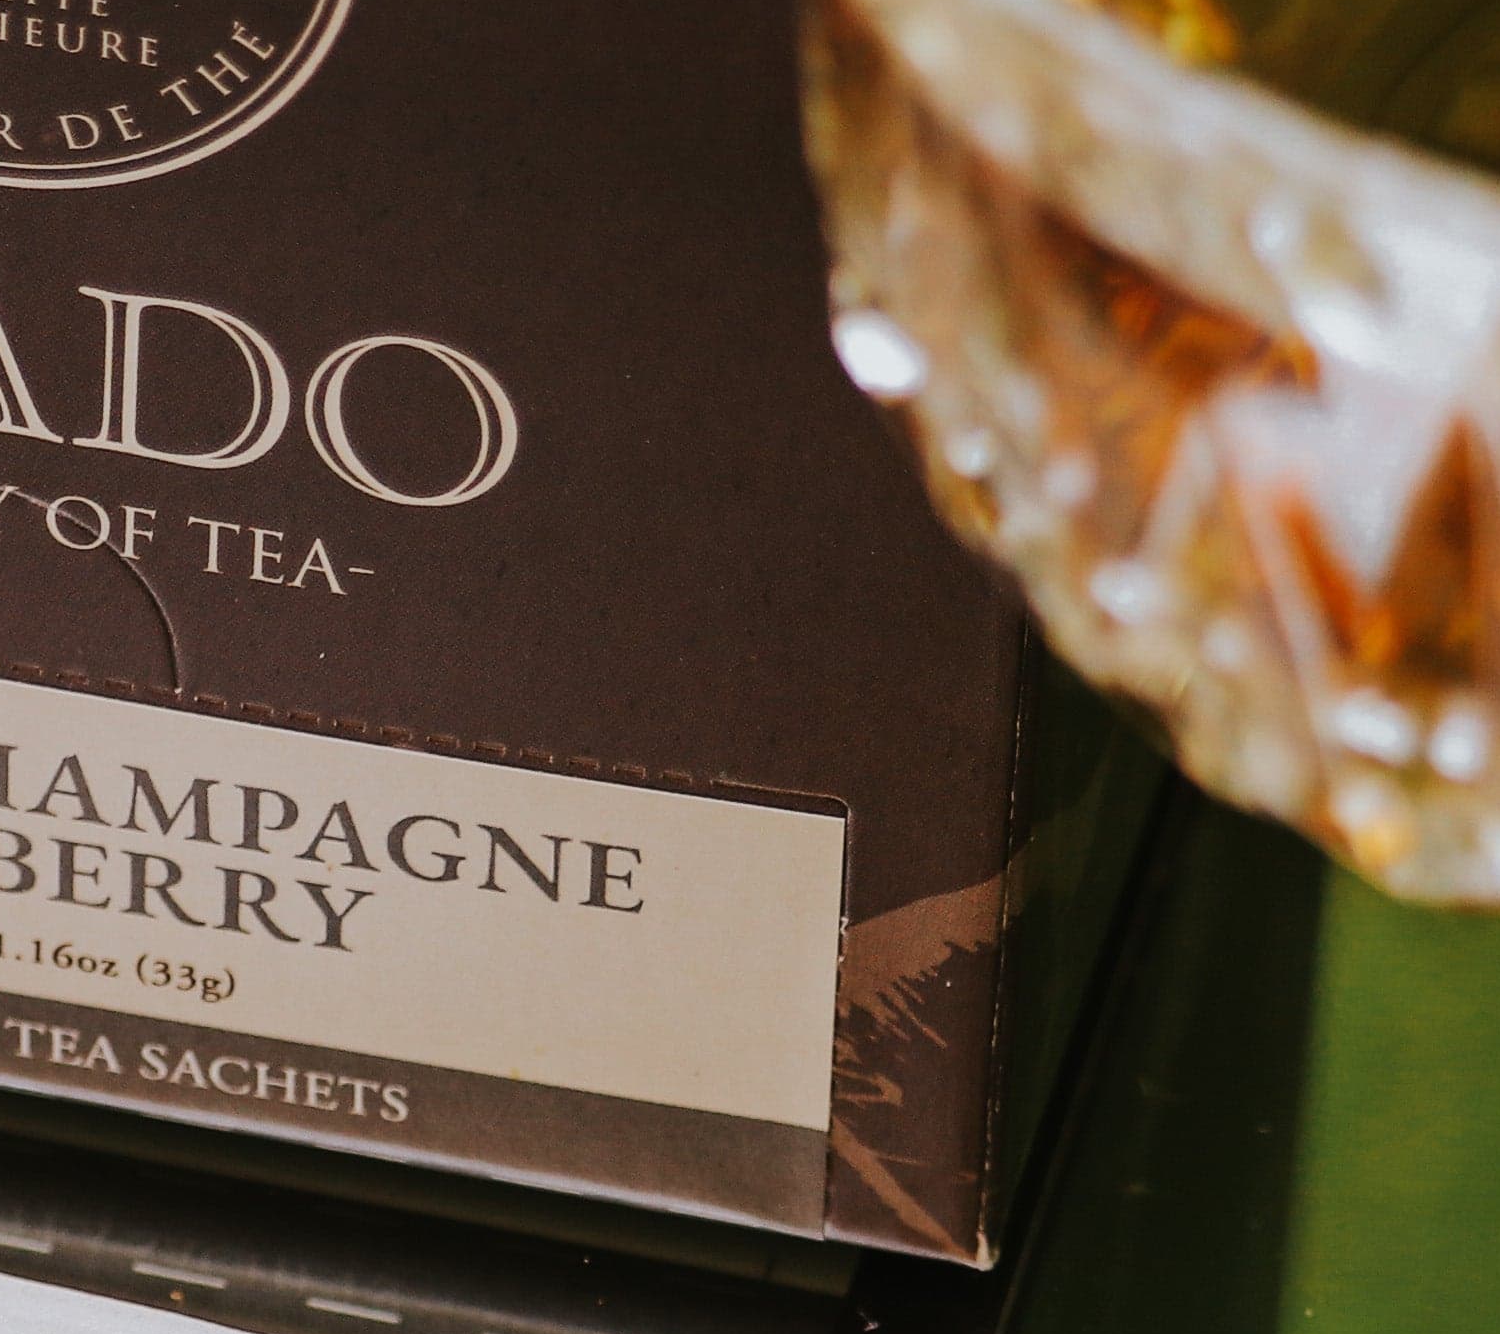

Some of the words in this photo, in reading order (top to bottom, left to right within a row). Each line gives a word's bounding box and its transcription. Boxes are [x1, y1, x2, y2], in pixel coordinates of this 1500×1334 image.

[60, 105, 142, 152] DE
[160, 20, 275, 118] THÉ
[45, 496, 154, 558] OF
[136, 952, 237, 1004] (33g)
[3, 1017, 121, 1074] TEA
[139, 1042, 411, 1125] SACHETS
